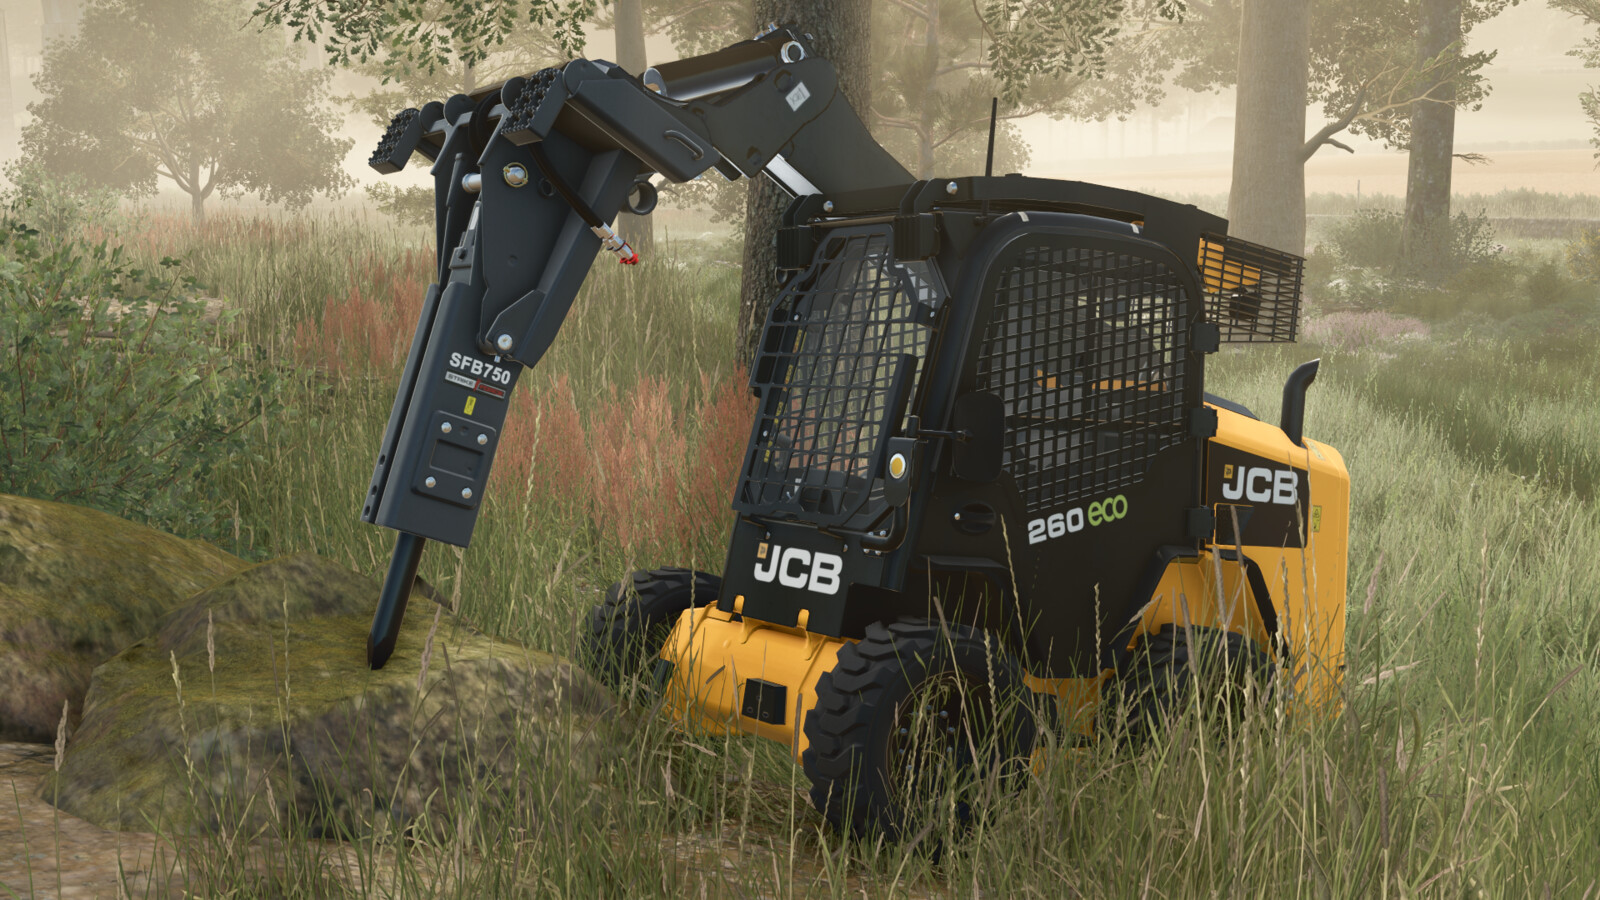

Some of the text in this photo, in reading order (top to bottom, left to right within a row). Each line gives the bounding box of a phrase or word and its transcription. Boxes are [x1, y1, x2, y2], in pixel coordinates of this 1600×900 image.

[449, 352, 511, 385] SFB750
[1222, 465, 1298, 505] JCB
[1027, 494, 1128, 545] 260 eco
[753, 544, 843, 595] JCB
